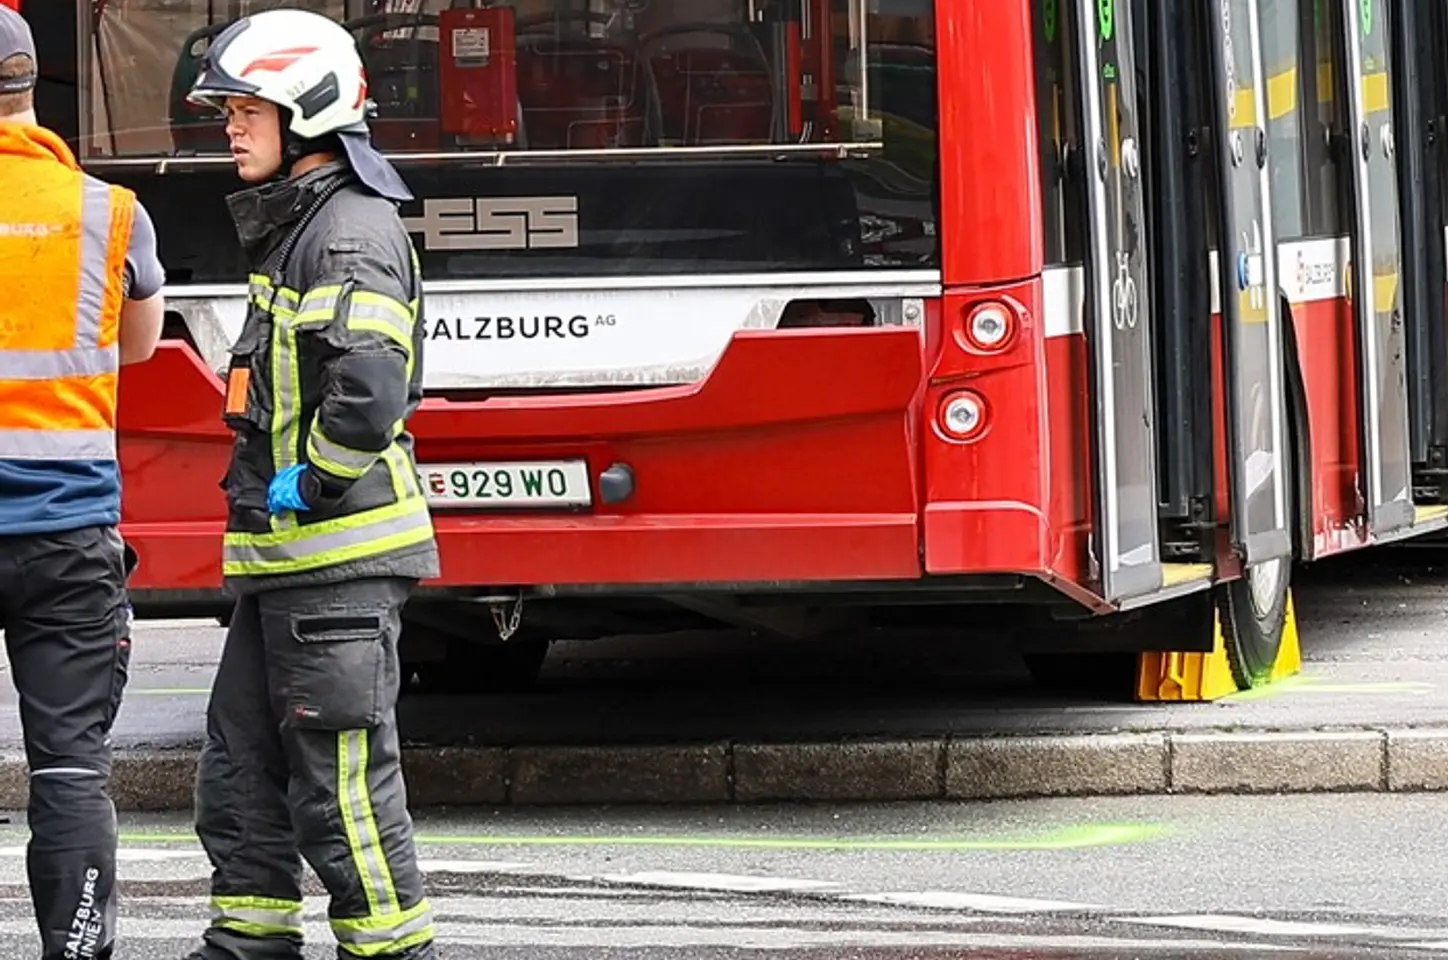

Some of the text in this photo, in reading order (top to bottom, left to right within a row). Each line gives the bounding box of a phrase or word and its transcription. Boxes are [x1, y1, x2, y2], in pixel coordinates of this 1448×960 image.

[595, 314, 616, 326] AG
[451, 470, 513, 498] 929
[63, 867, 99, 960] SALZBURG
[80, 909, 102, 960] INIEN
